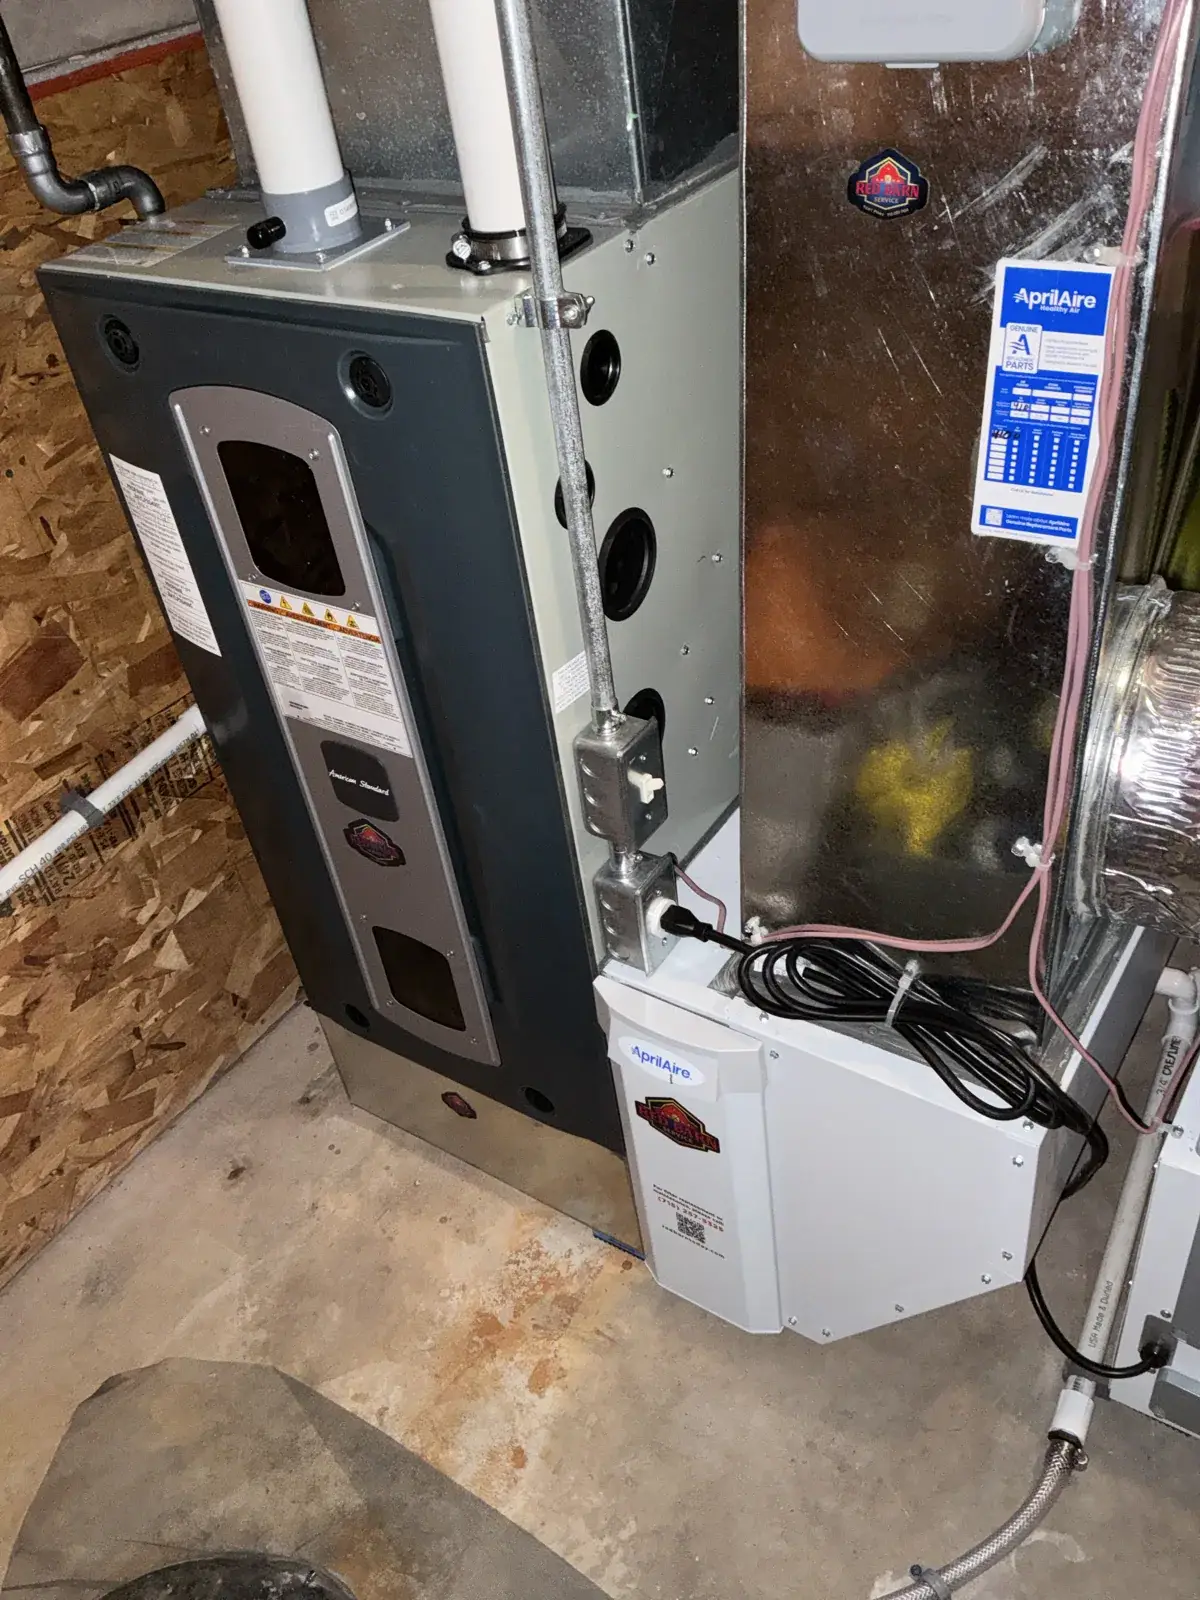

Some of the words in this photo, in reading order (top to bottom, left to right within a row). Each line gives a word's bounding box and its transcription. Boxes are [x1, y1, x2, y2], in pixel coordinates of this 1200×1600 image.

[856, 181, 881, 195] RED
[884, 184, 919, 199] BARN
[874, 196, 899, 204] SERVICE
[1013, 288, 1096, 310] AprilAire
[1040, 305, 1068, 314] Healthy
[1009, 324, 1038, 333] GENUINE
[1005, 360, 1034, 371] PARTS
[329, 769, 357, 784] American
[359, 780, 389, 796] Standard
[18, 864, 40, 885] SCH
[39, 852, 53, 866] 40
[630, 1045, 692, 1079] AprilAire
[1092, 1312, 1105, 1332] Made
